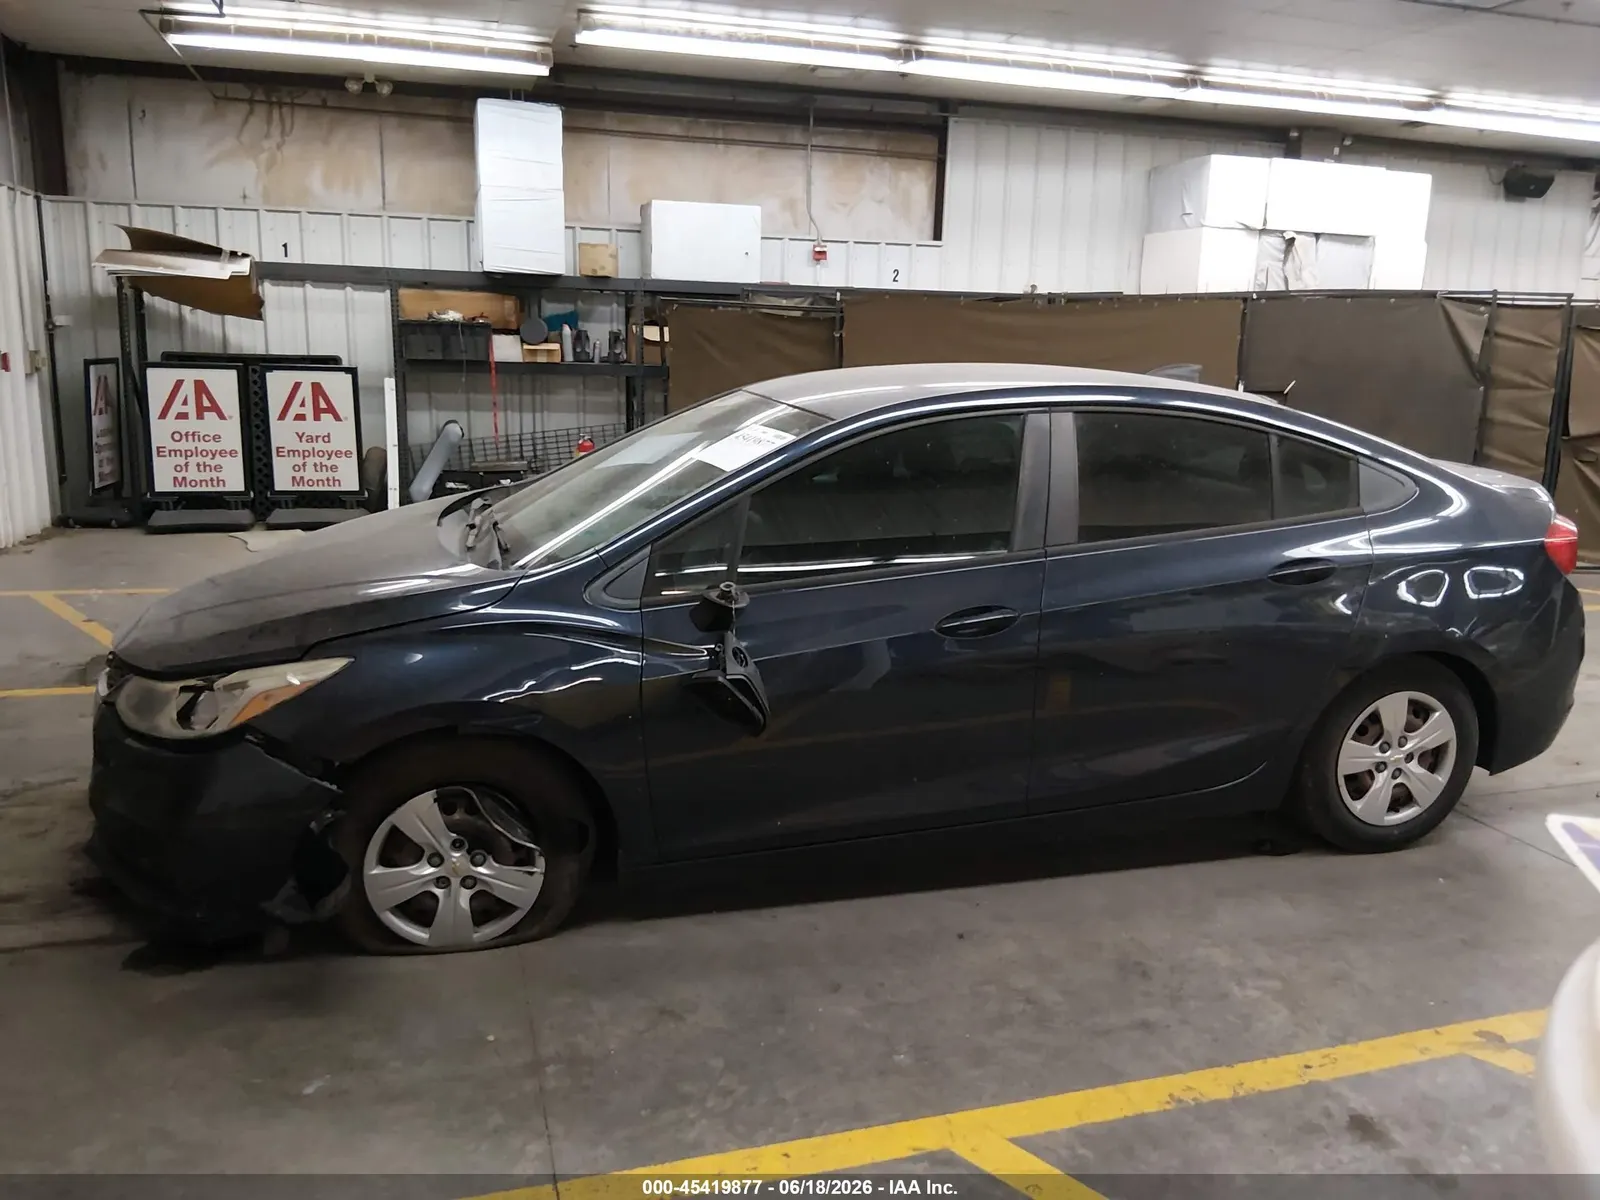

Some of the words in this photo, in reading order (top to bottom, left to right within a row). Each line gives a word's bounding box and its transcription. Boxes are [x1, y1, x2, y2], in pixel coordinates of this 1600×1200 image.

[281, 242, 288, 258] 1
[892, 268, 899, 283] 2
[170, 430, 222, 443] Office
[295, 431, 331, 443] Yard
[156, 446, 238, 460] Employee
[276, 446, 353, 460] Employee
[173, 461, 190, 473] of
[196, 461, 223, 473] the
[292, 461, 308, 473] of
[313, 461, 339, 473] the
[173, 476, 226, 488] Month
[291, 475, 342, 488] Month
